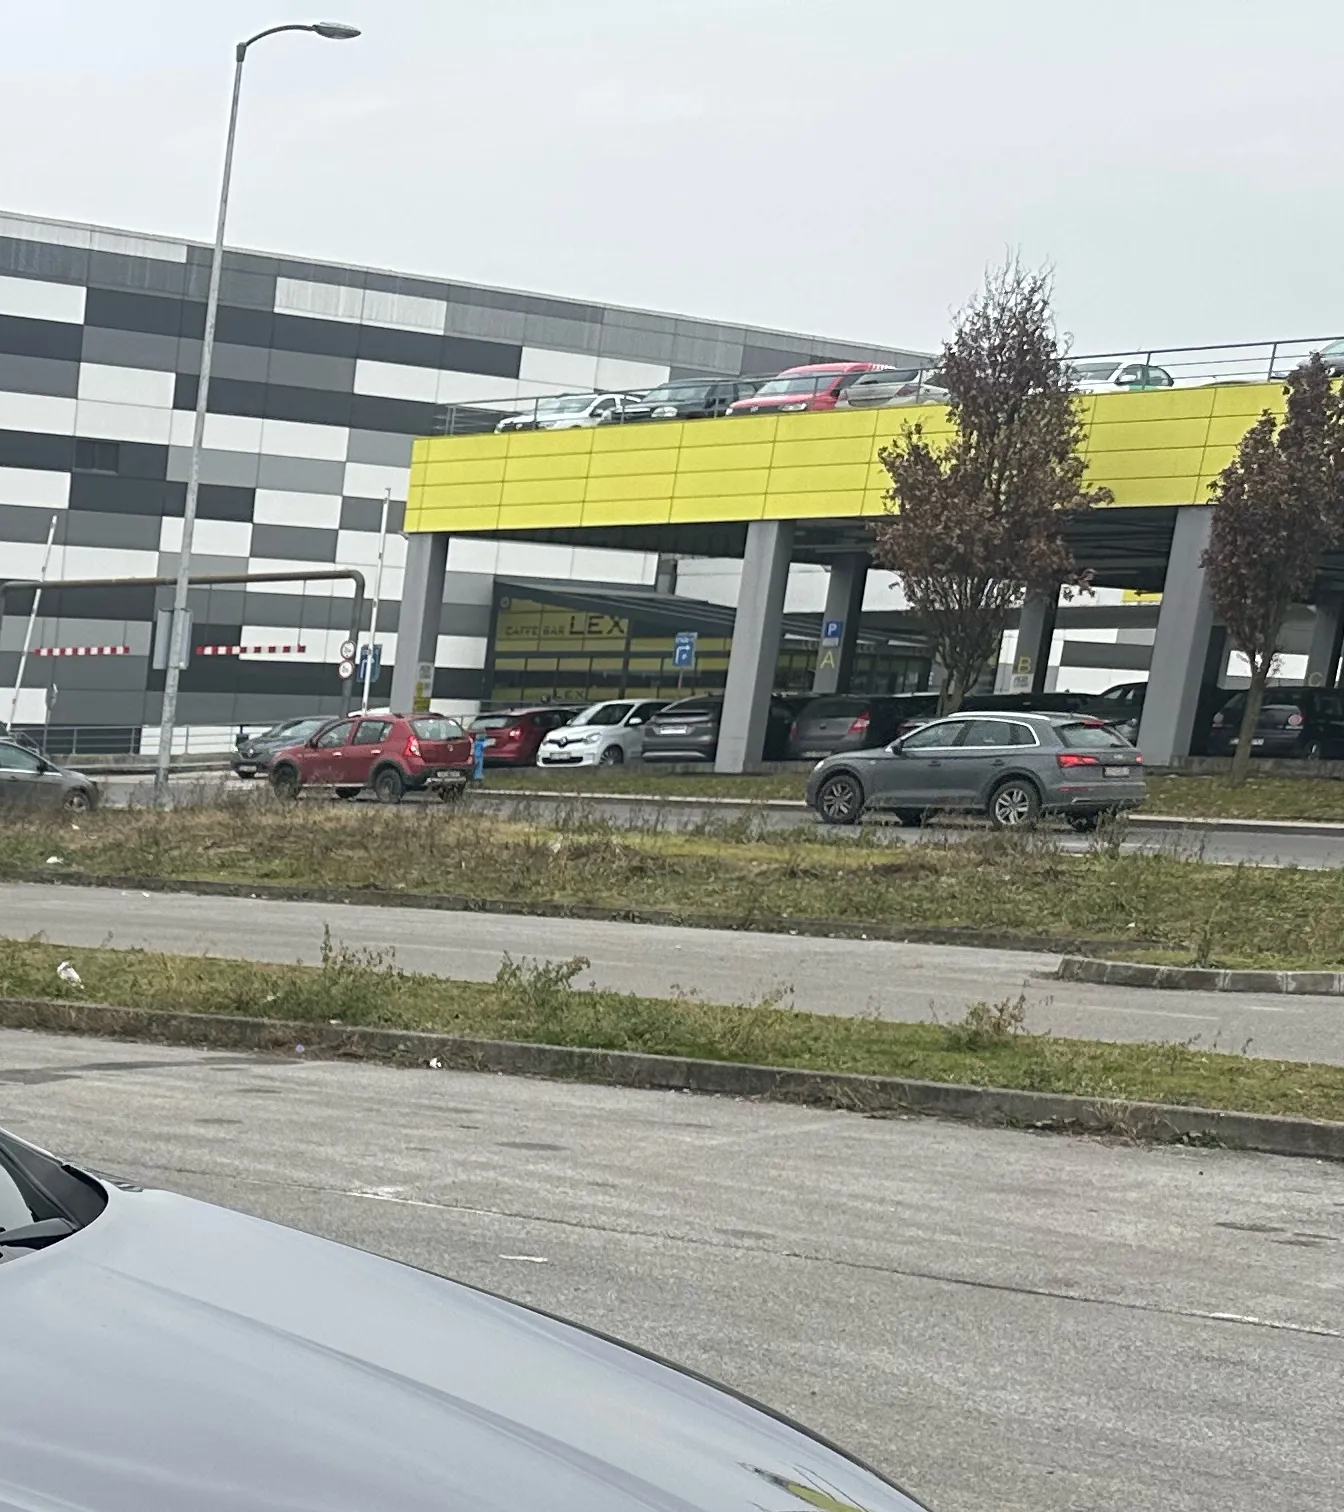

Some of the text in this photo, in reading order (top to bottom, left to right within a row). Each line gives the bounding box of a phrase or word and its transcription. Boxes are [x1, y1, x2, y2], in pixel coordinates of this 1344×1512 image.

[569, 615, 625, 635] LEX
[827, 623, 838, 637] P
[820, 651, 835, 669] A
[1018, 656, 1031, 674] B
